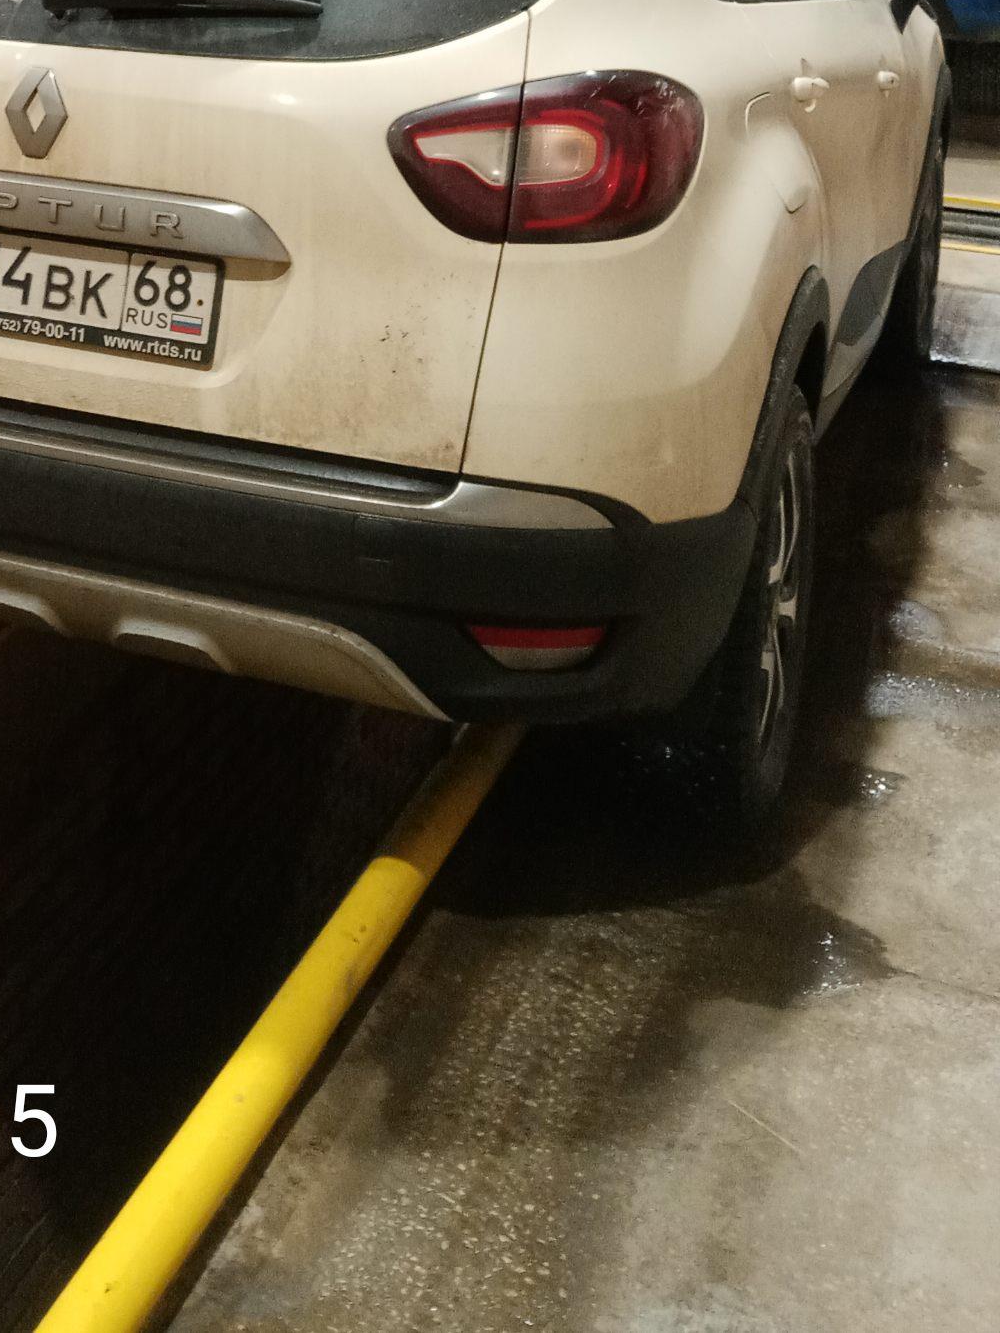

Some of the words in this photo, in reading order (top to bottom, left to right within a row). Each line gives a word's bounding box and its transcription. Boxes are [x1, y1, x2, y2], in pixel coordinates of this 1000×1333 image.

[133, 260, 193, 312] 68
[22, 318, 86, 343] 79-00-11
[103, 332, 202, 362] www.rtds.ru
[126, 308, 168, 329] RUS
